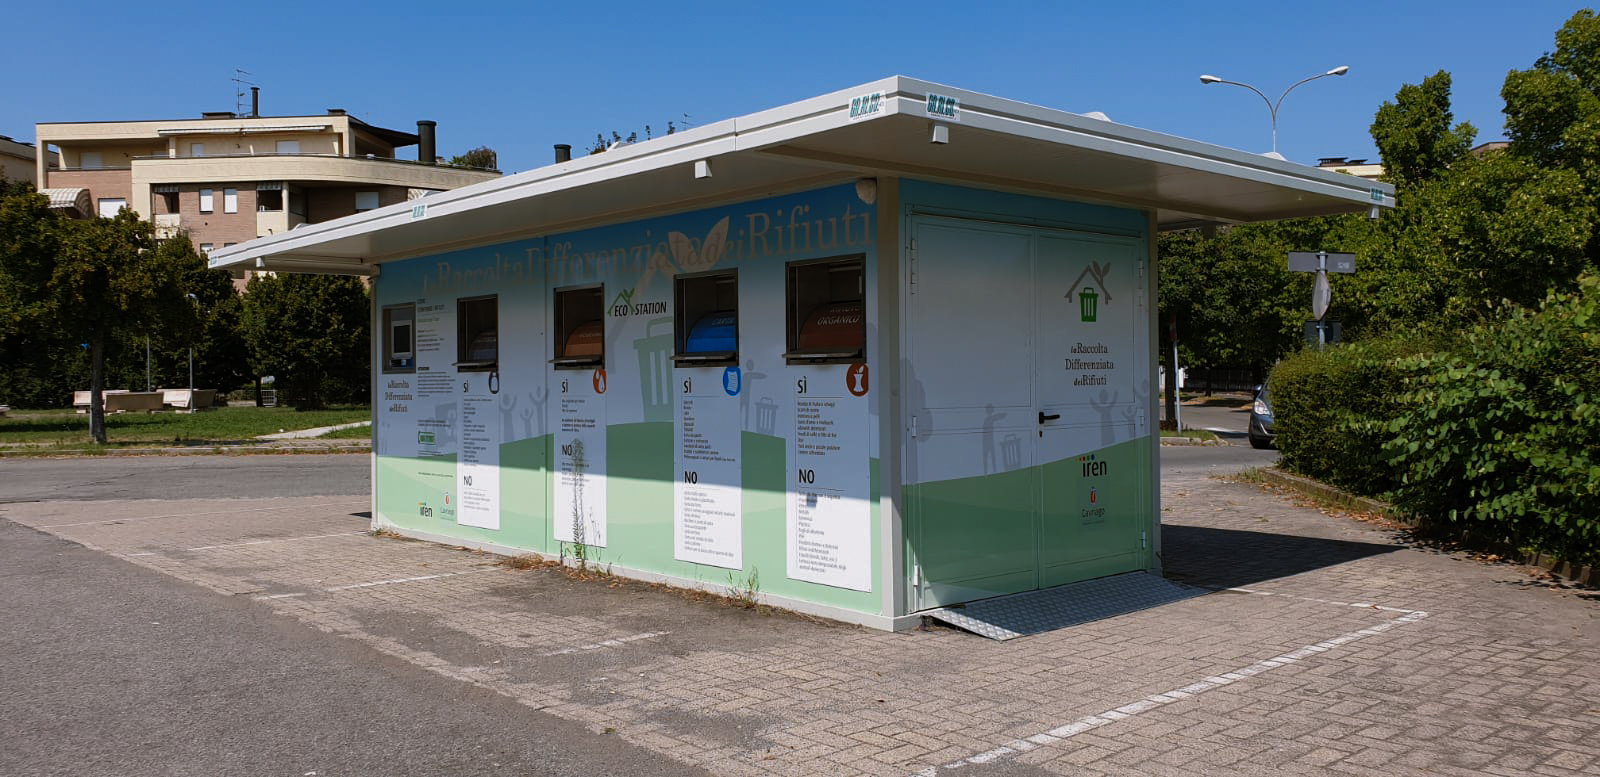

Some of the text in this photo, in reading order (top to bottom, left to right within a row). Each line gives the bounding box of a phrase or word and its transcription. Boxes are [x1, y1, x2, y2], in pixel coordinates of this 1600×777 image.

[614, 301, 667, 317] ECO STATION
[1065, 358, 1114, 370] Differenziata
[561, 444, 573, 457] NO
[463, 475, 473, 487] NO
[684, 470, 698, 485] NO
[798, 468, 815, 484] NO
